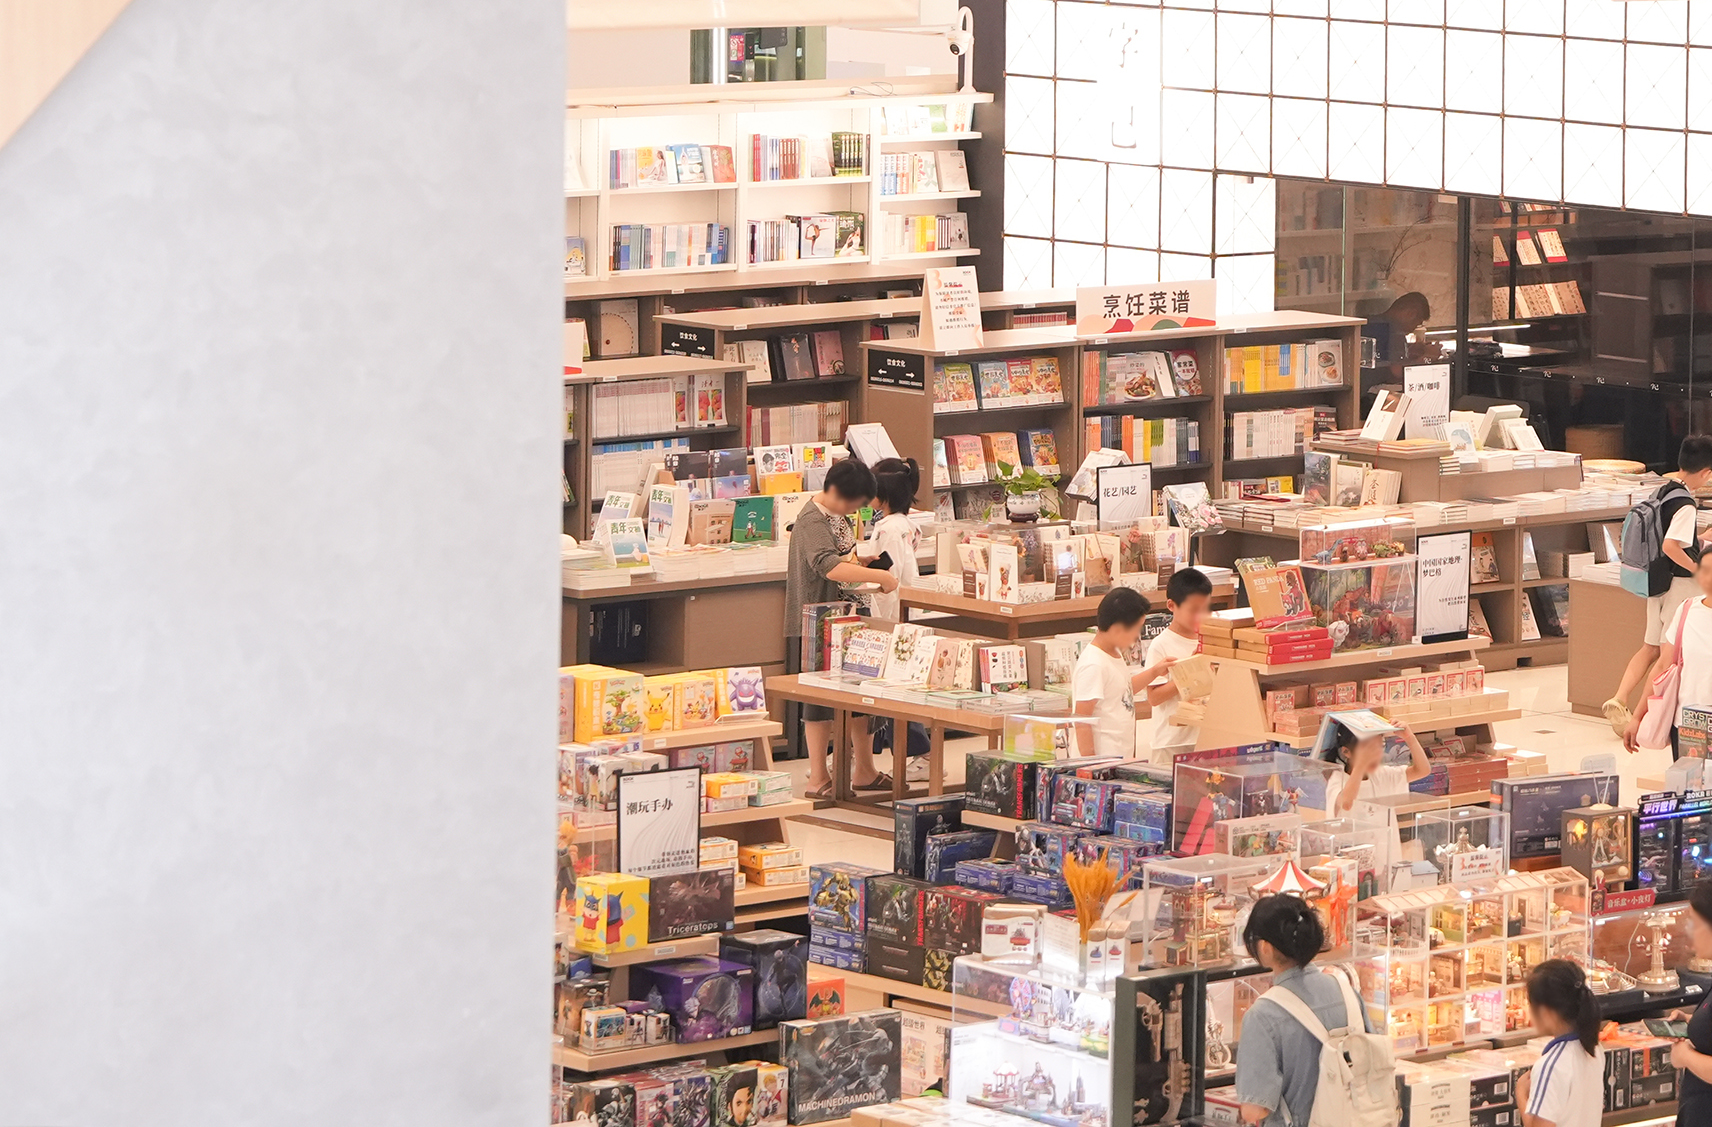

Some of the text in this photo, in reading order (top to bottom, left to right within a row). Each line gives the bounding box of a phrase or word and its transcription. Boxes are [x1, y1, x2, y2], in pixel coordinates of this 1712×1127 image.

[1103, 288, 1191, 319] 烹饪菜谱
[886, 358, 906, 369] 饮食文化
[1408, 381, 1440, 392] 茶/酒/咖啡
[1102, 485, 1137, 498] 花艺/园艺
[1682, 709, 1709, 721] CRYST
[626, 797, 674, 816] 潮玩手办
[1642, 798, 1678, 815] 平行世界
[917, 890, 925, 946] TRANSFORMERS
[667, 921, 719, 935] Triceratops
[902, 1016, 926, 1030] 超级世界
[797, 1091, 877, 1113] MACHINEDRAMON
